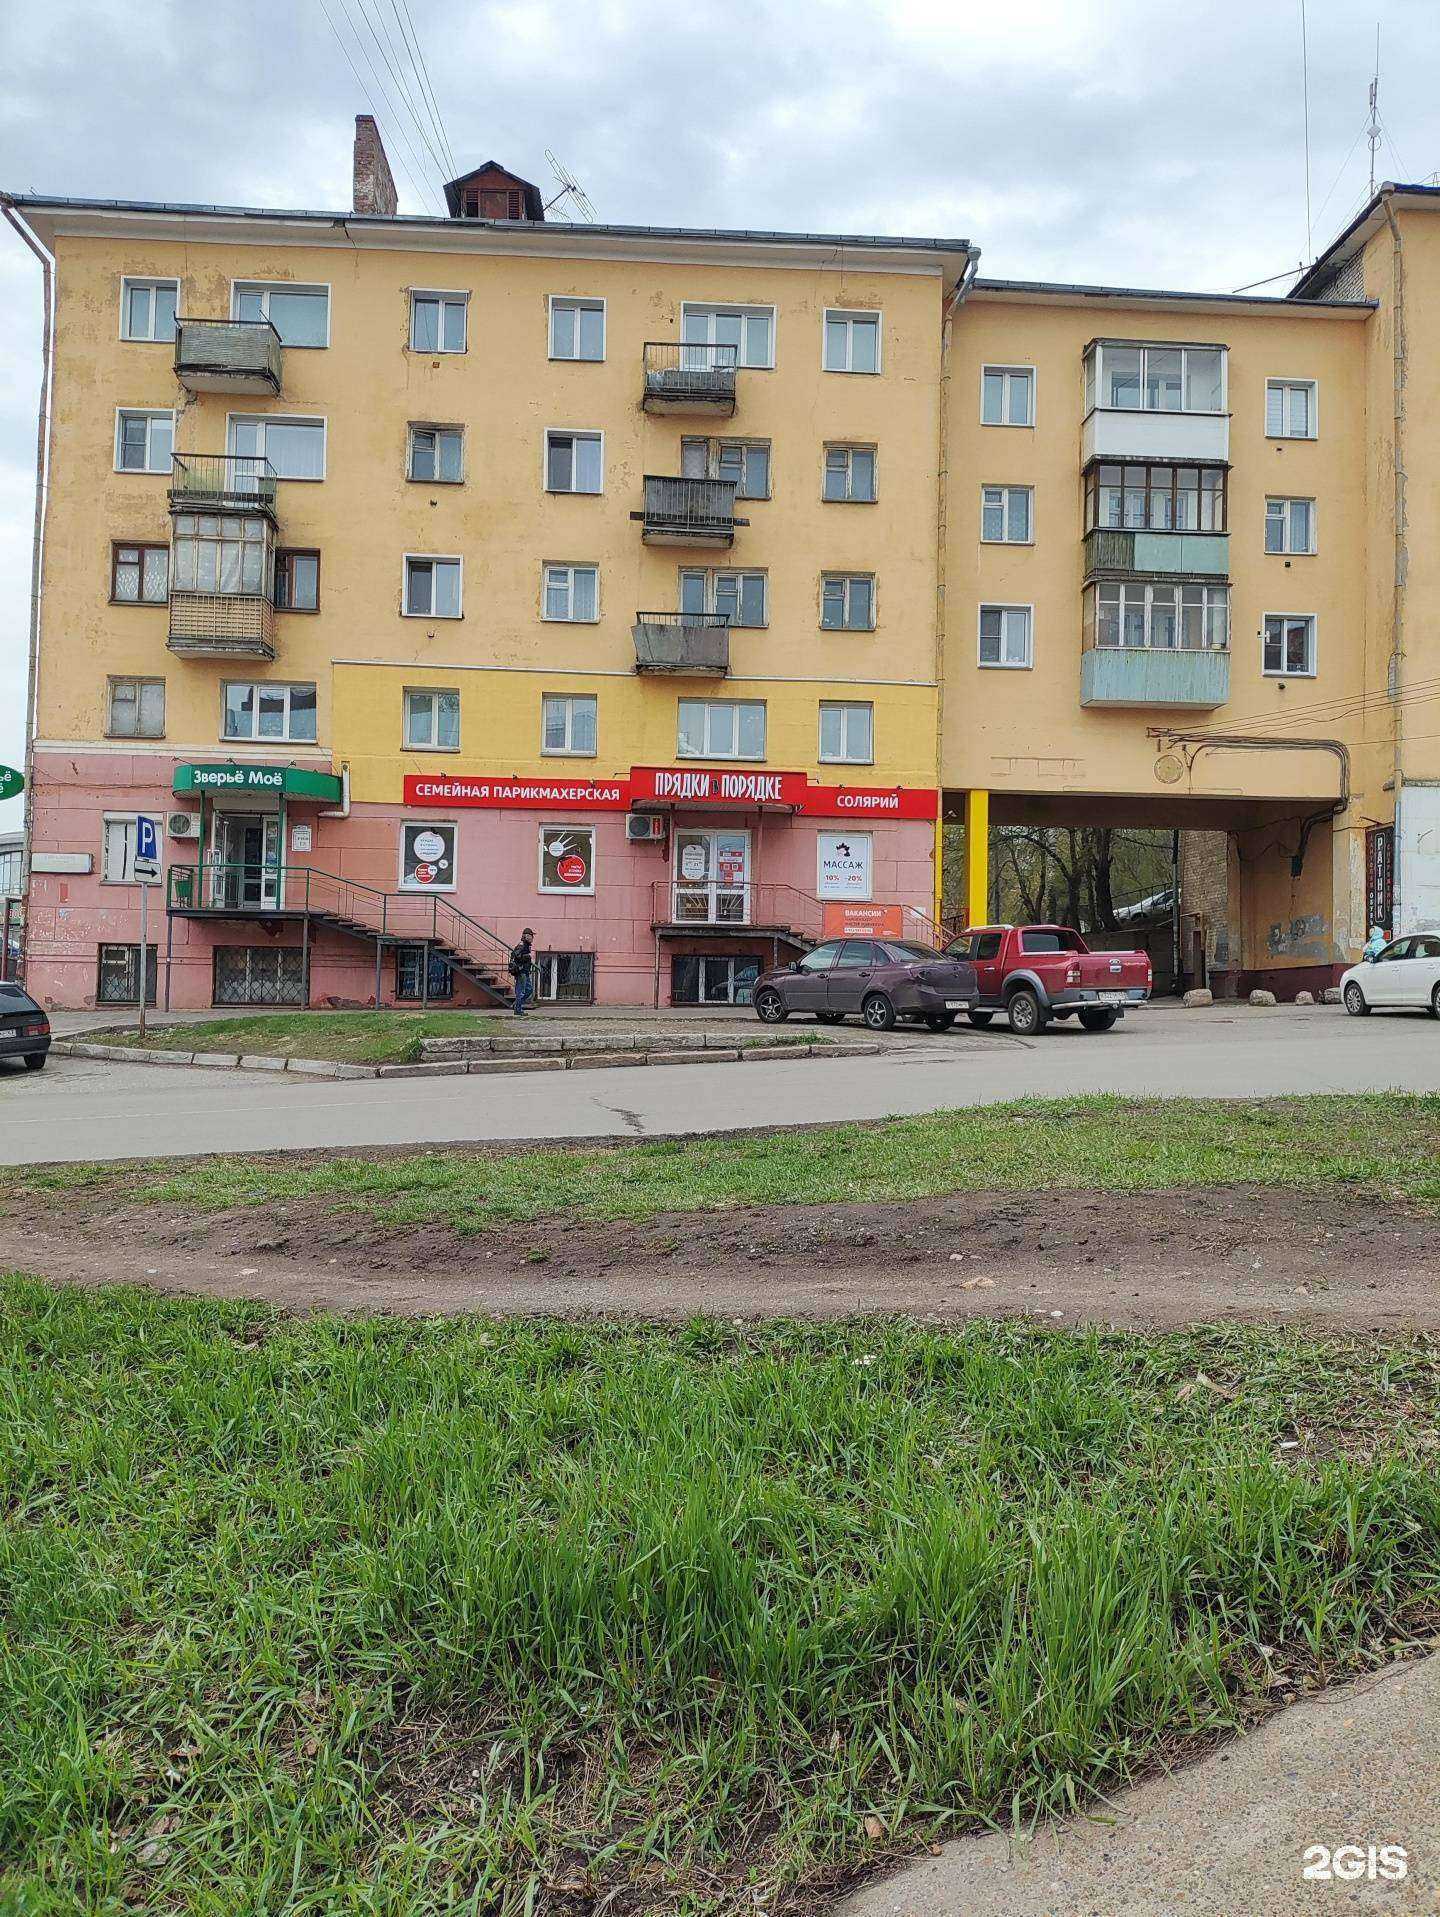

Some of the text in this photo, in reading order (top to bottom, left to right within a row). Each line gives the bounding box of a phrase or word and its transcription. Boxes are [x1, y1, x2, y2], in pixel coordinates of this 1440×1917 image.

[194, 770, 283, 786] Зверьё Моё
[415, 783, 620, 800] СЕМЕЙНАЯ ПАРИКМАХЕРСКАЯ
[655, 772, 710, 798] ПРЯДКИ
[721, 775, 782, 801] ПОРЯДКЕ
[837, 793, 899, 809] СОЛЯРИЙ
[141, 822, 153, 854] P
[824, 860, 863, 869] МАССАЖ
[845, 909, 881, 917] ВАКАНСИИ
